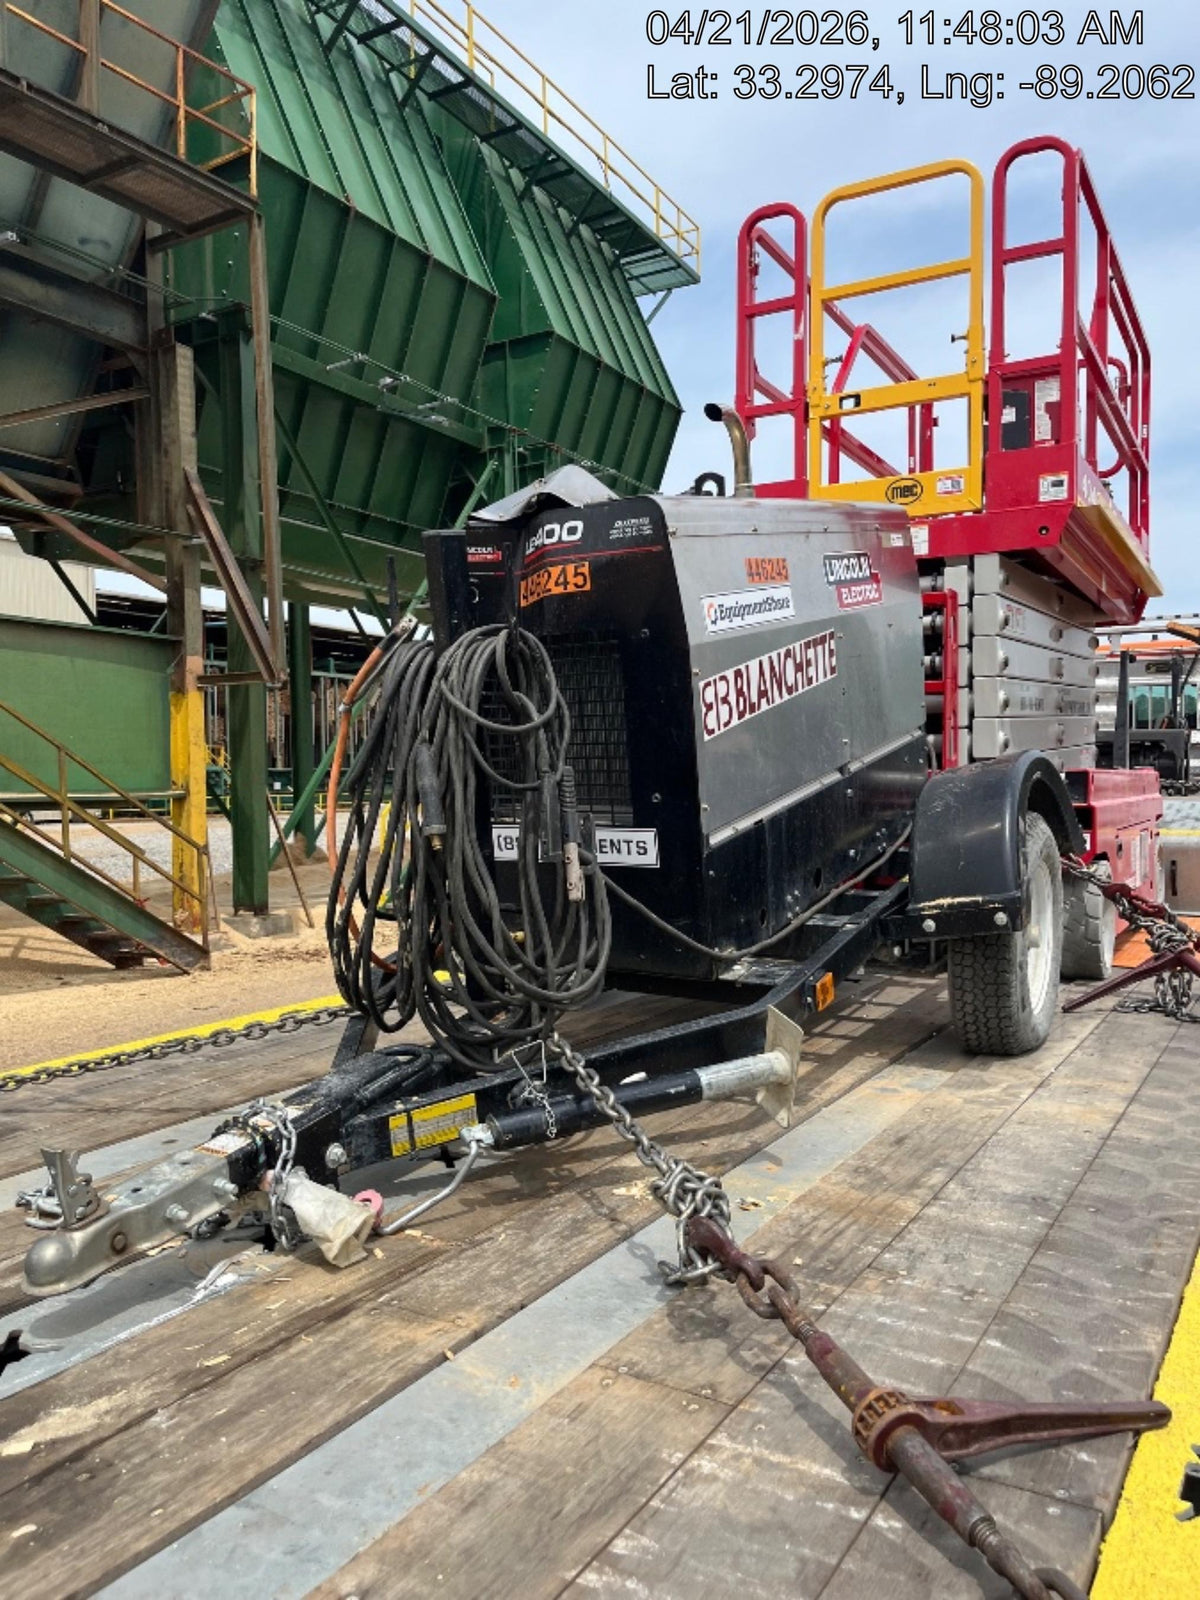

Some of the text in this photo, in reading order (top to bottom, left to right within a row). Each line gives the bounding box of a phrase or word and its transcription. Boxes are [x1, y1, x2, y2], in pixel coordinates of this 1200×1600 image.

[747, 558, 789, 582] 446245
[825, 556, 870, 582] LINCOLN
[840, 583, 879, 604] ELECTRIC
[717, 596, 791, 623] EquipmentShare
[734, 630, 837, 722] BLANCHETTE
[595, 838, 648, 856] ENTS
